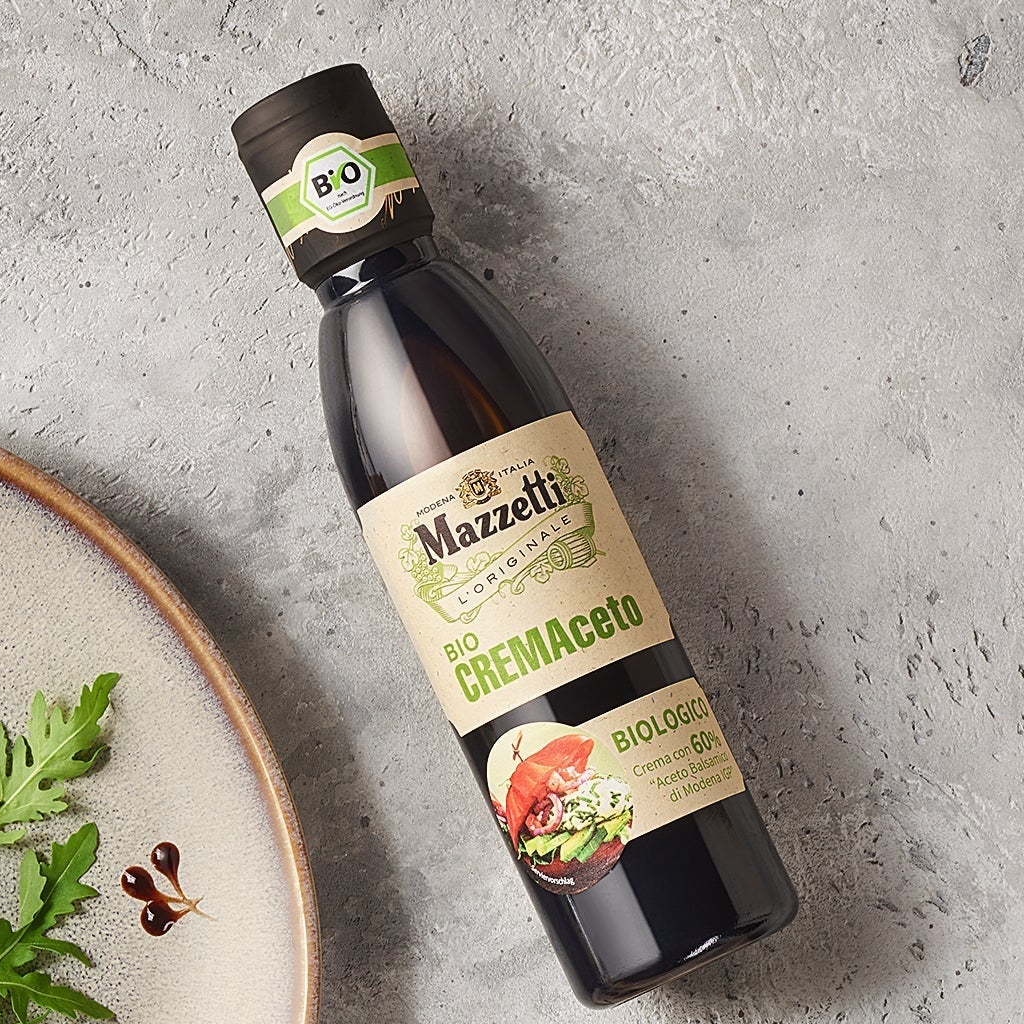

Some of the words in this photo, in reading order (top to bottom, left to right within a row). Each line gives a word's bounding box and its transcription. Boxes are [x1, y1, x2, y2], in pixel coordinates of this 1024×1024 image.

[311, 161, 361, 198] BiO
[416, 494, 456, 517] MODENA
[498, 457, 535, 478] ITALIA
[413, 469, 567, 566] Mazzetti
[458, 514, 572, 605] L'ORIGINALE
[443, 632, 480, 663] BIO
[454, 594, 644, 703] CREMAceto
[610, 697, 709, 753] BIOLOGICO
[632, 755, 673, 777] Crema
[672, 746, 692, 761] con
[690, 730, 722, 755] 60%
[688, 751, 729, 775] Balsamico
[670, 788, 682, 803] di
[683, 773, 722, 796] Modena
